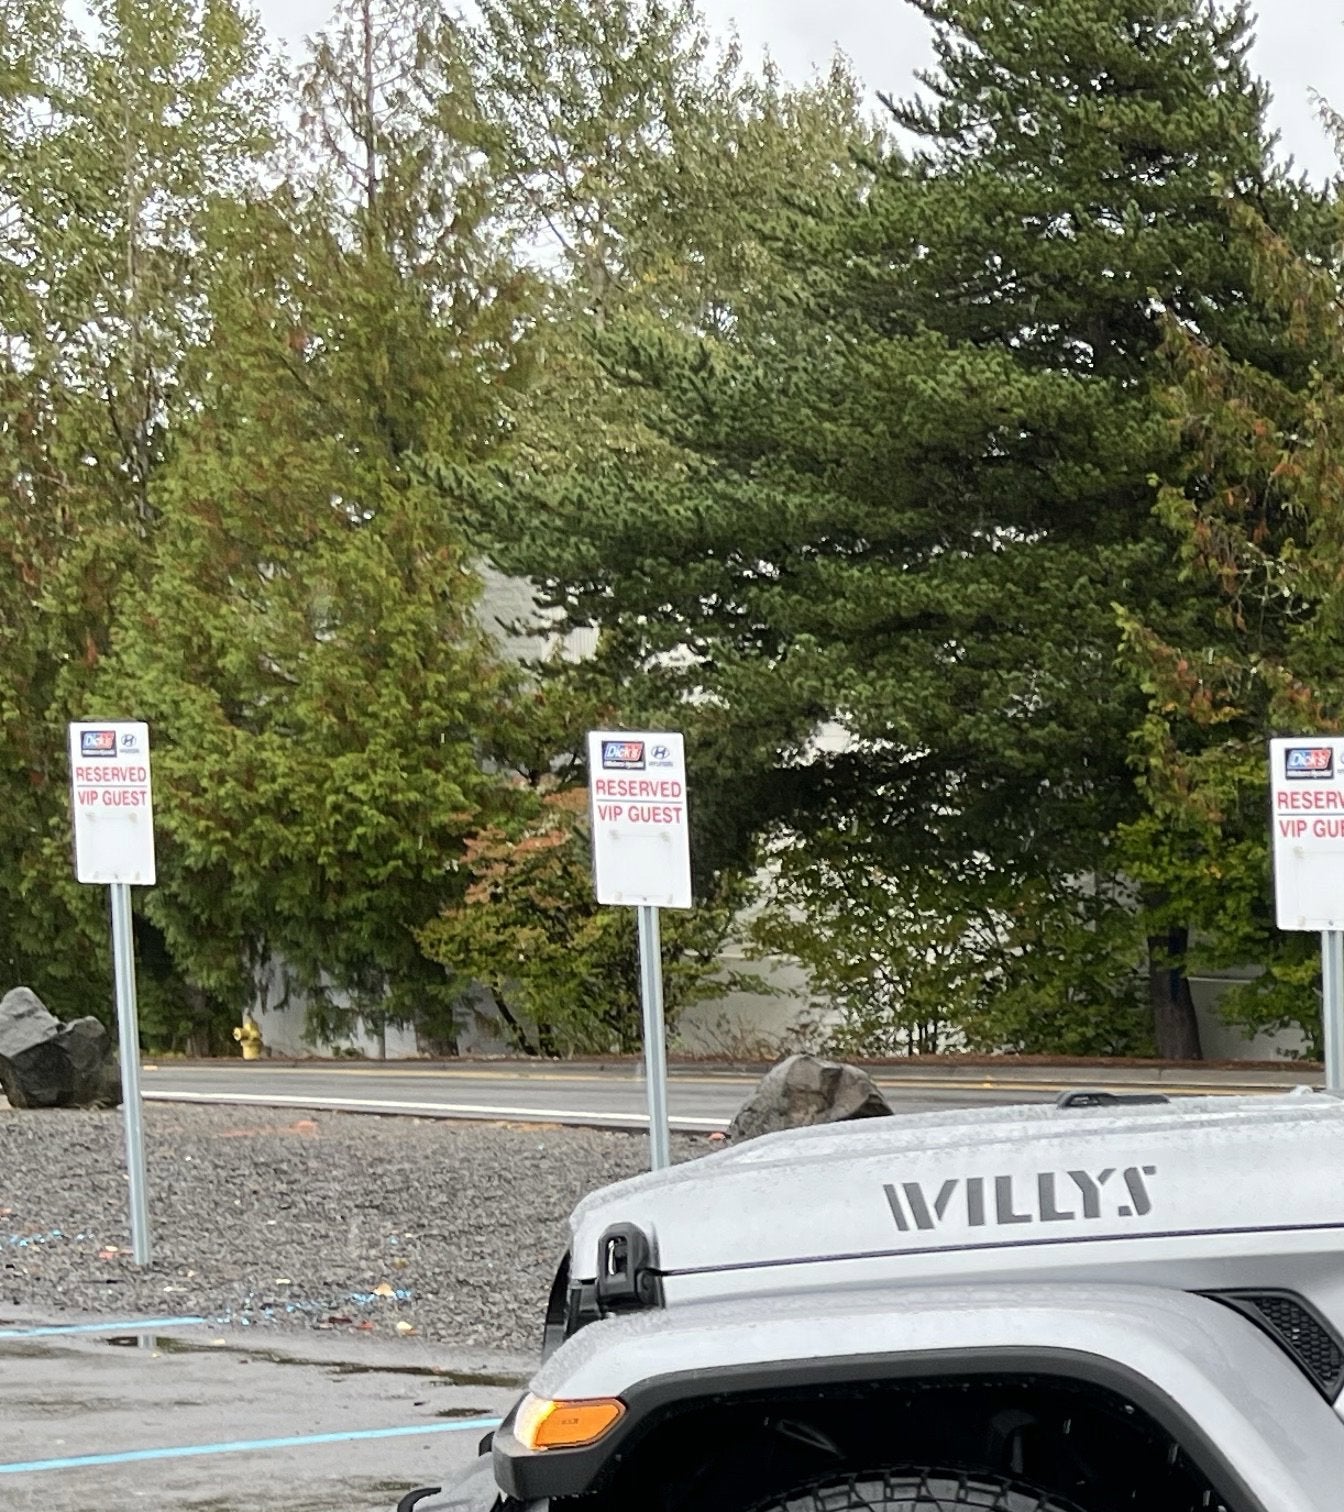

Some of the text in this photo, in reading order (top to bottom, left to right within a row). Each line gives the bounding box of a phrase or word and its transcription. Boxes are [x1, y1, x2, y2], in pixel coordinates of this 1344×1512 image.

[76, 767, 147, 783] RESERVED
[78, 790, 147, 806] VIP GUEST
[596, 780, 682, 798] RESERVED
[598, 805, 682, 824] VIP GUEST
[1279, 820, 1307, 838] VIP
[882, 1165, 1157, 1231] WILLYS
